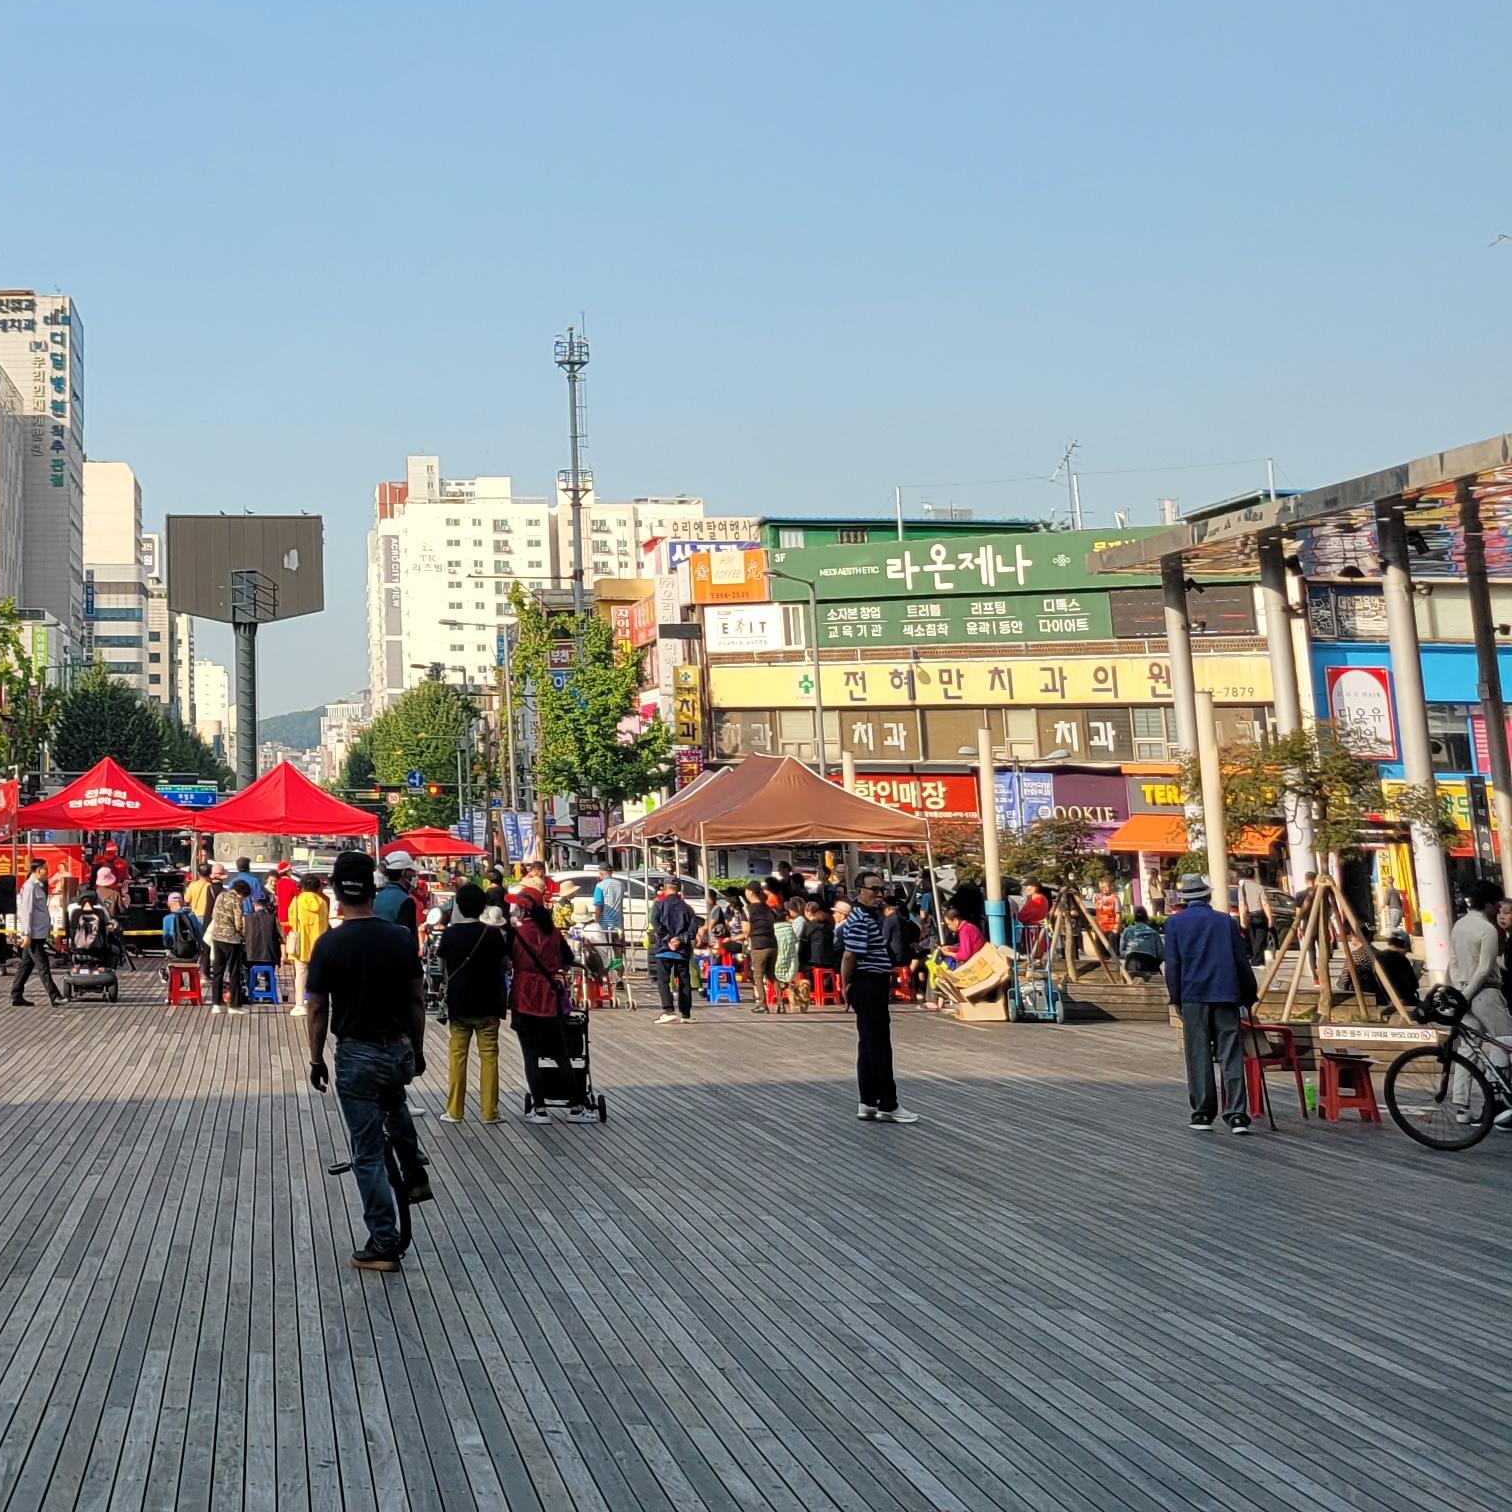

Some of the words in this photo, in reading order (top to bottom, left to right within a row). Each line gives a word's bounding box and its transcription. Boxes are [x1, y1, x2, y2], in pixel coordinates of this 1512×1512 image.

[670, 519, 752, 542] 오리엔탈여행사
[418, 554, 437, 563] TK
[774, 552, 786, 563] 3F
[885, 542, 1033, 591] 라온제나
[826, 607, 859, 621] 소자본
[859, 606, 882, 620] 창업
[905, 603, 942, 618] 트러블
[969, 600, 1008, 616] 리프팅
[1042, 598, 1082, 614] 디톡스
[827, 624, 883, 640] 교육기관
[901, 621, 950, 637] 색소침착
[965, 620, 991, 636] 윤곽
[1038, 617, 1090, 634] 다이어트
[1201, 687, 1255, 698] 2-7879
[678, 697, 698, 742] 치과
[1336, 705, 1385, 725] 디오유
[851, 721, 907, 753] 치과
[1053, 719, 1117, 751] 치과
[1053, 805, 1116, 823] OOKIE
